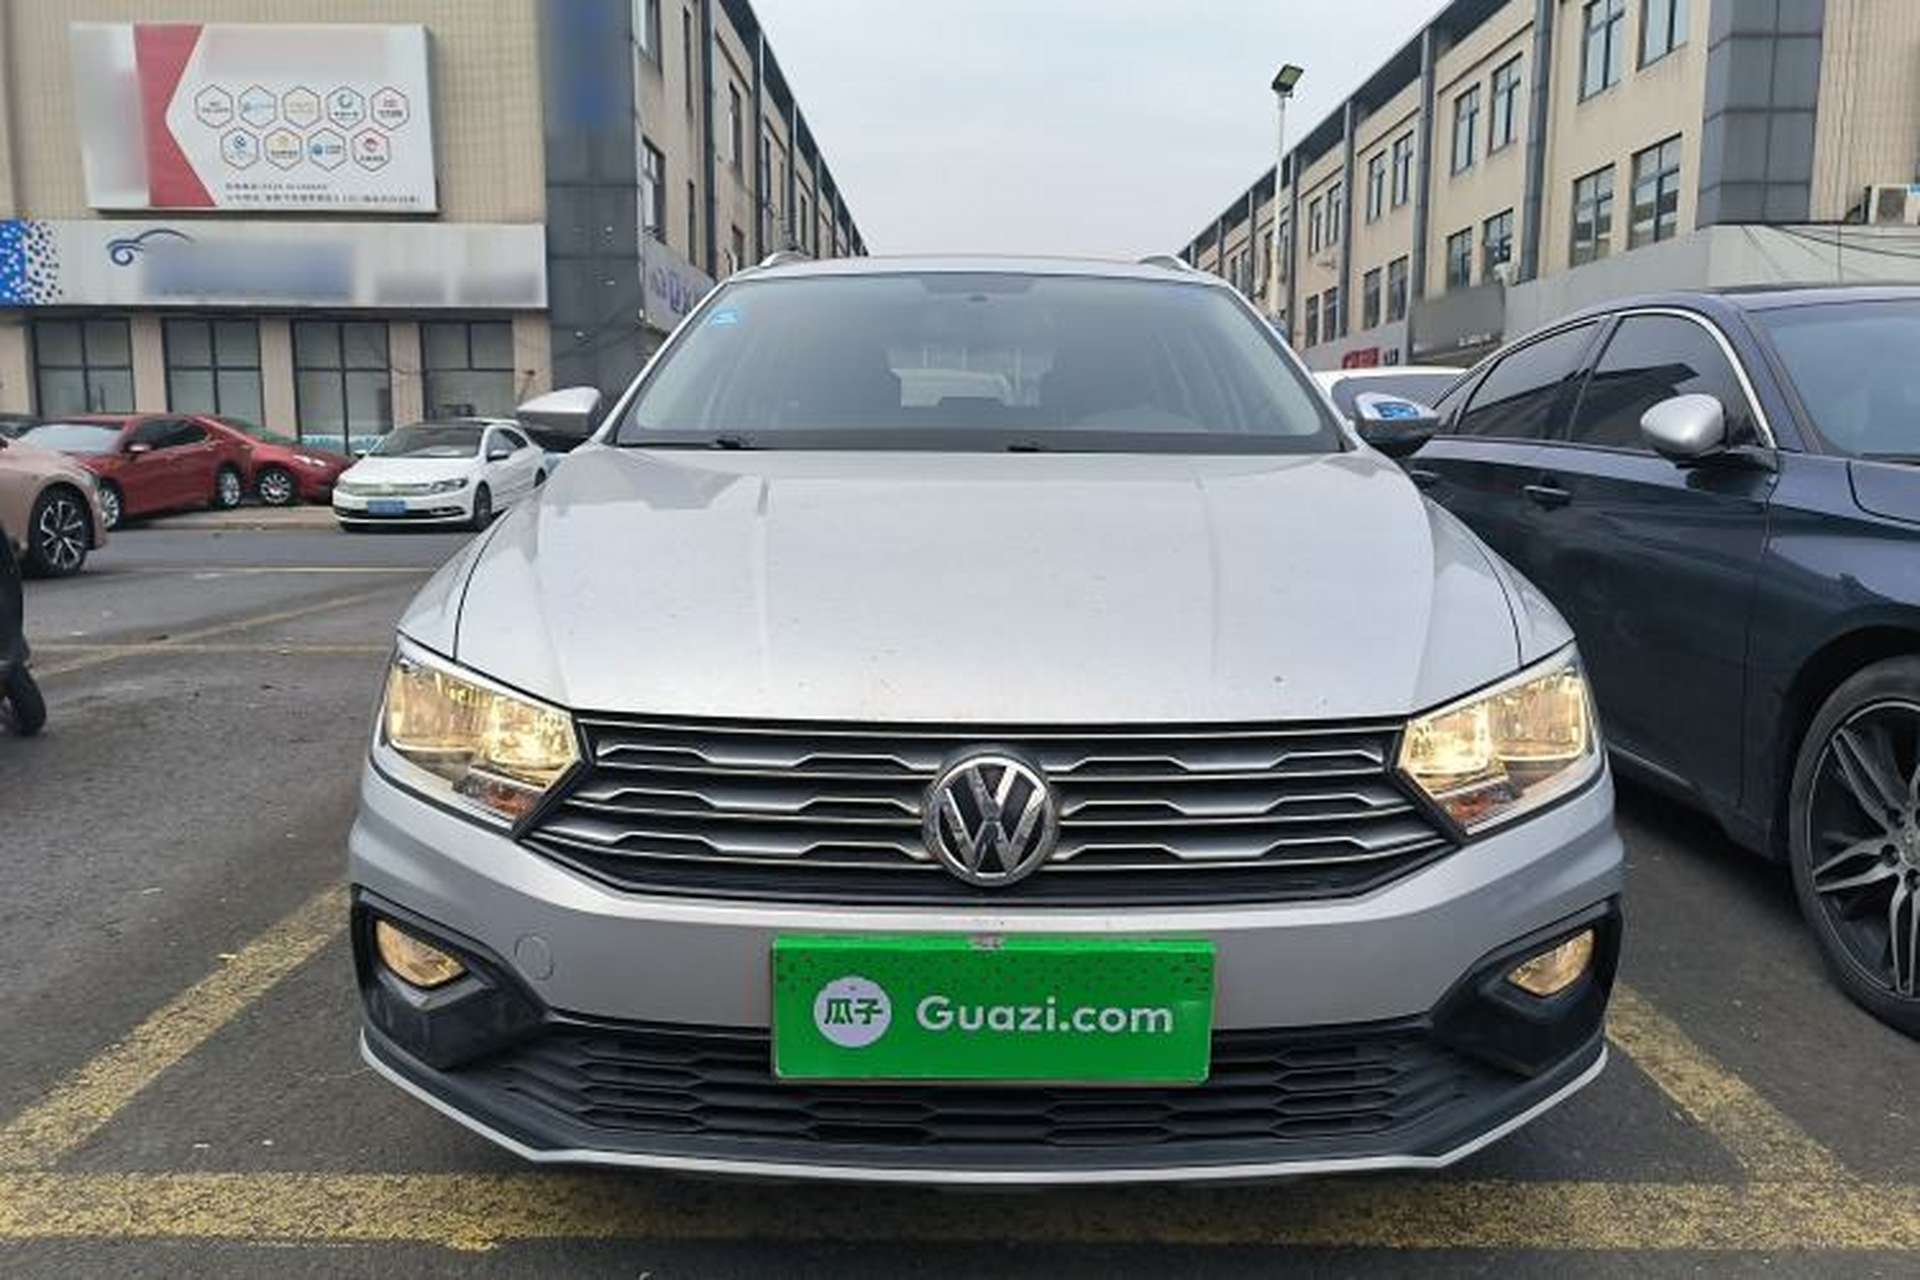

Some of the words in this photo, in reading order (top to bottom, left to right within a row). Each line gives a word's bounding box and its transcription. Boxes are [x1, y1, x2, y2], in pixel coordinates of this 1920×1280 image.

[929, 752, 1052, 880] VW
[824, 998, 884, 1025] 瓜子
[915, 995, 1174, 1034] Guazi.com
